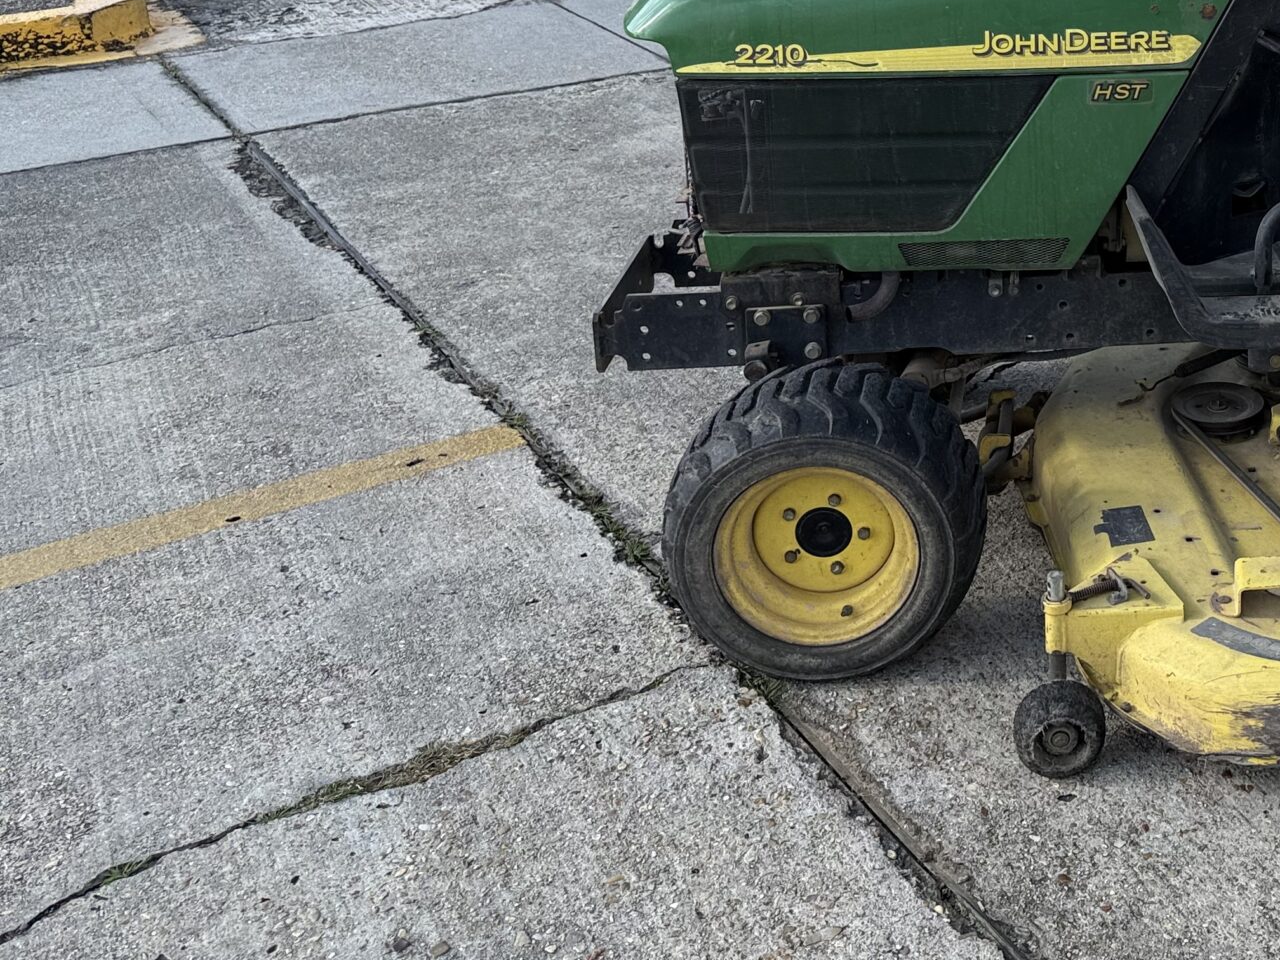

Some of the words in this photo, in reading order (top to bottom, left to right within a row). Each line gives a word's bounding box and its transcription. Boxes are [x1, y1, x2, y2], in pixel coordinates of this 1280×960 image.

[973, 30, 1061, 56] JOHN
[1065, 28, 1170, 53] DEERE
[735, 43, 807, 66] 2210
[1092, 83, 1148, 102] HST
